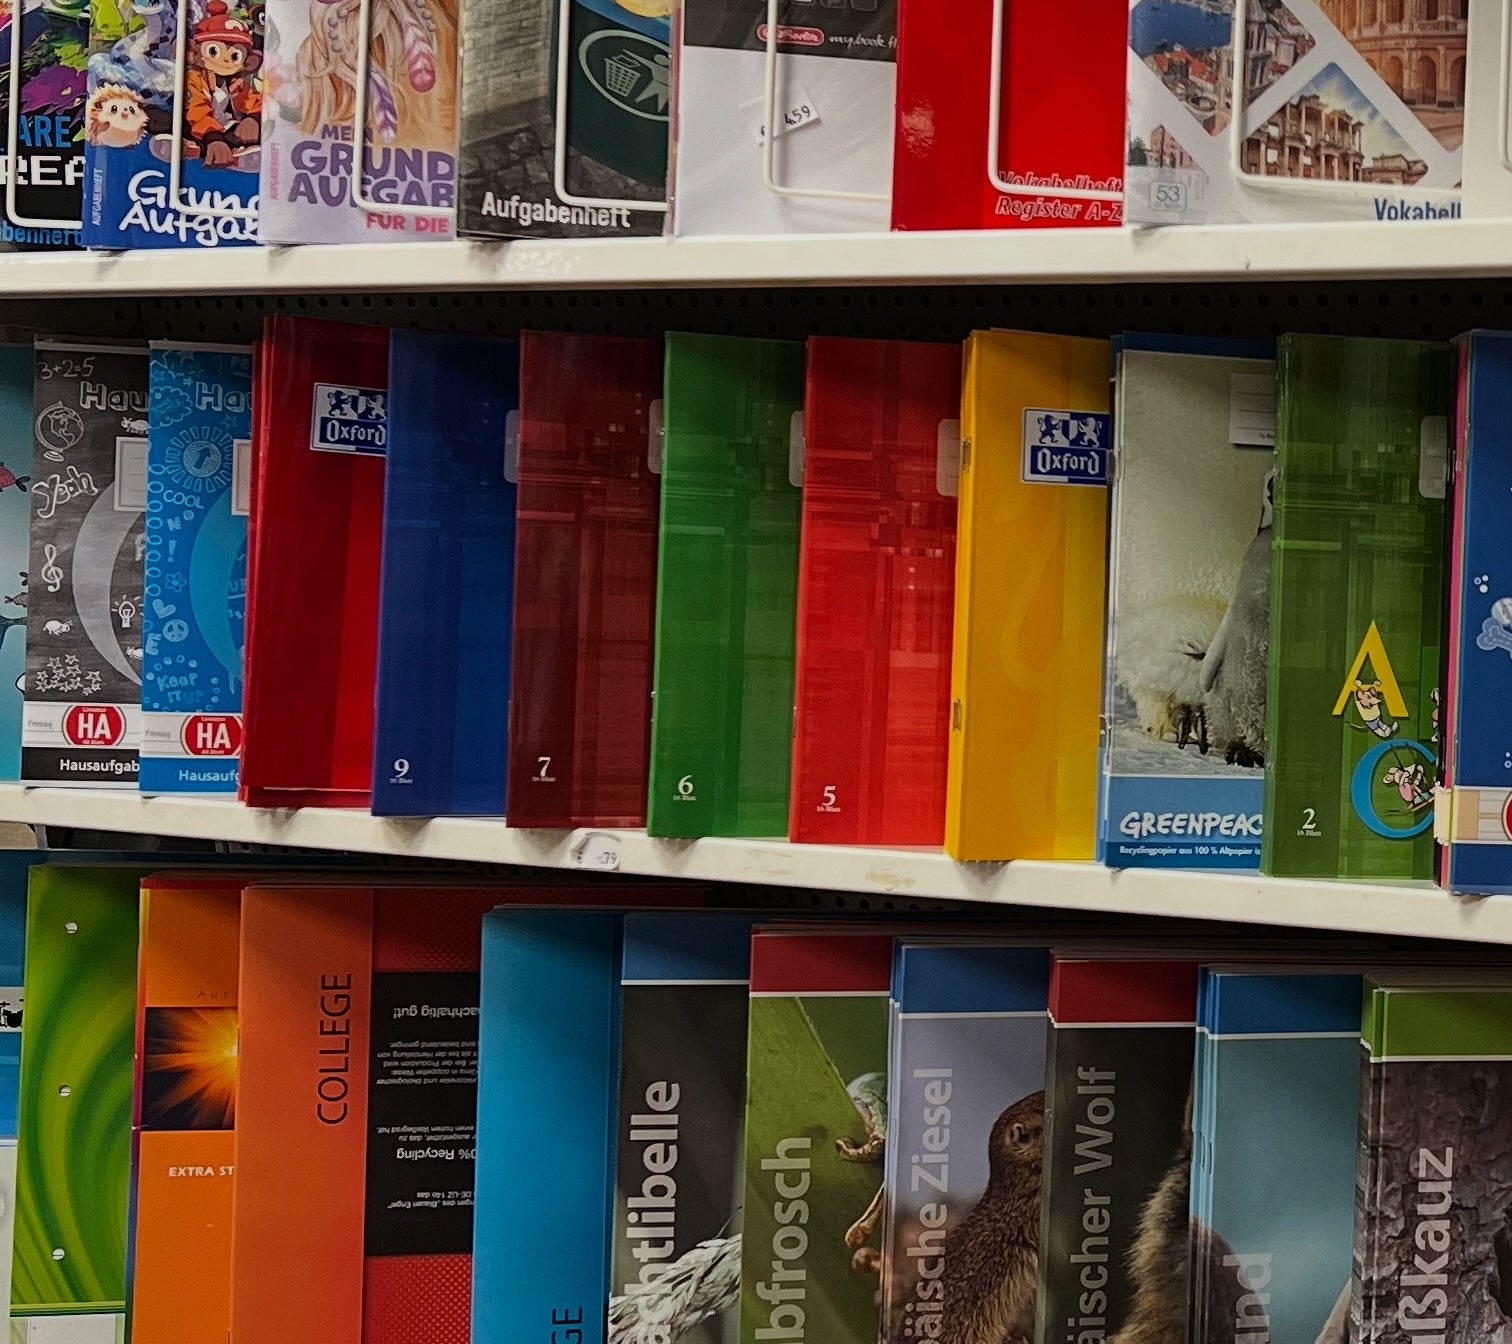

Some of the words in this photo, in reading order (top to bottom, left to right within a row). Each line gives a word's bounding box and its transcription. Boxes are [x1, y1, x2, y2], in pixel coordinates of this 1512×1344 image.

[291, 140, 455, 183] GRUND
[1156, 184, 1181, 203] 53
[481, 191, 631, 229] Aufgabenheft
[995, 196, 1081, 222] Register
[1084, 201, 1123, 222] A-Z
[415, 217, 449, 233] DIE
[38, 357, 96, 380] 3+2=5
[326, 419, 386, 444] Oxford
[1036, 449, 1100, 475] Oxford
[32, 466, 99, 518] Yeah
[1333, 620, 1409, 718] A
[77, 712, 112, 740] HA
[197, 722, 231, 750] HA
[60, 759, 139, 775] Hausaufgab
[394, 758, 410, 779] 9
[538, 756, 552, 777] 7
[677, 775, 694, 795] 6
[821, 785, 836, 806] 5
[1119, 811, 1263, 839] GREENPEAC
[1302, 808, 1317, 830] 2
[1119, 845, 1178, 857] Recyclingpapier
[1195, 845, 1209, 855] 100
[1219, 845, 1254, 857] Altpapier
[317, 973, 352, 1125] COLLEGE
[911, 1067, 953, 1194] Ziesel
[1073, 1065, 1118, 1177] Wolf
[396, 1146, 454, 1161] Recycling
[168, 1166, 214, 1178] EXTRA
[219, 1165, 235, 1177] ST
